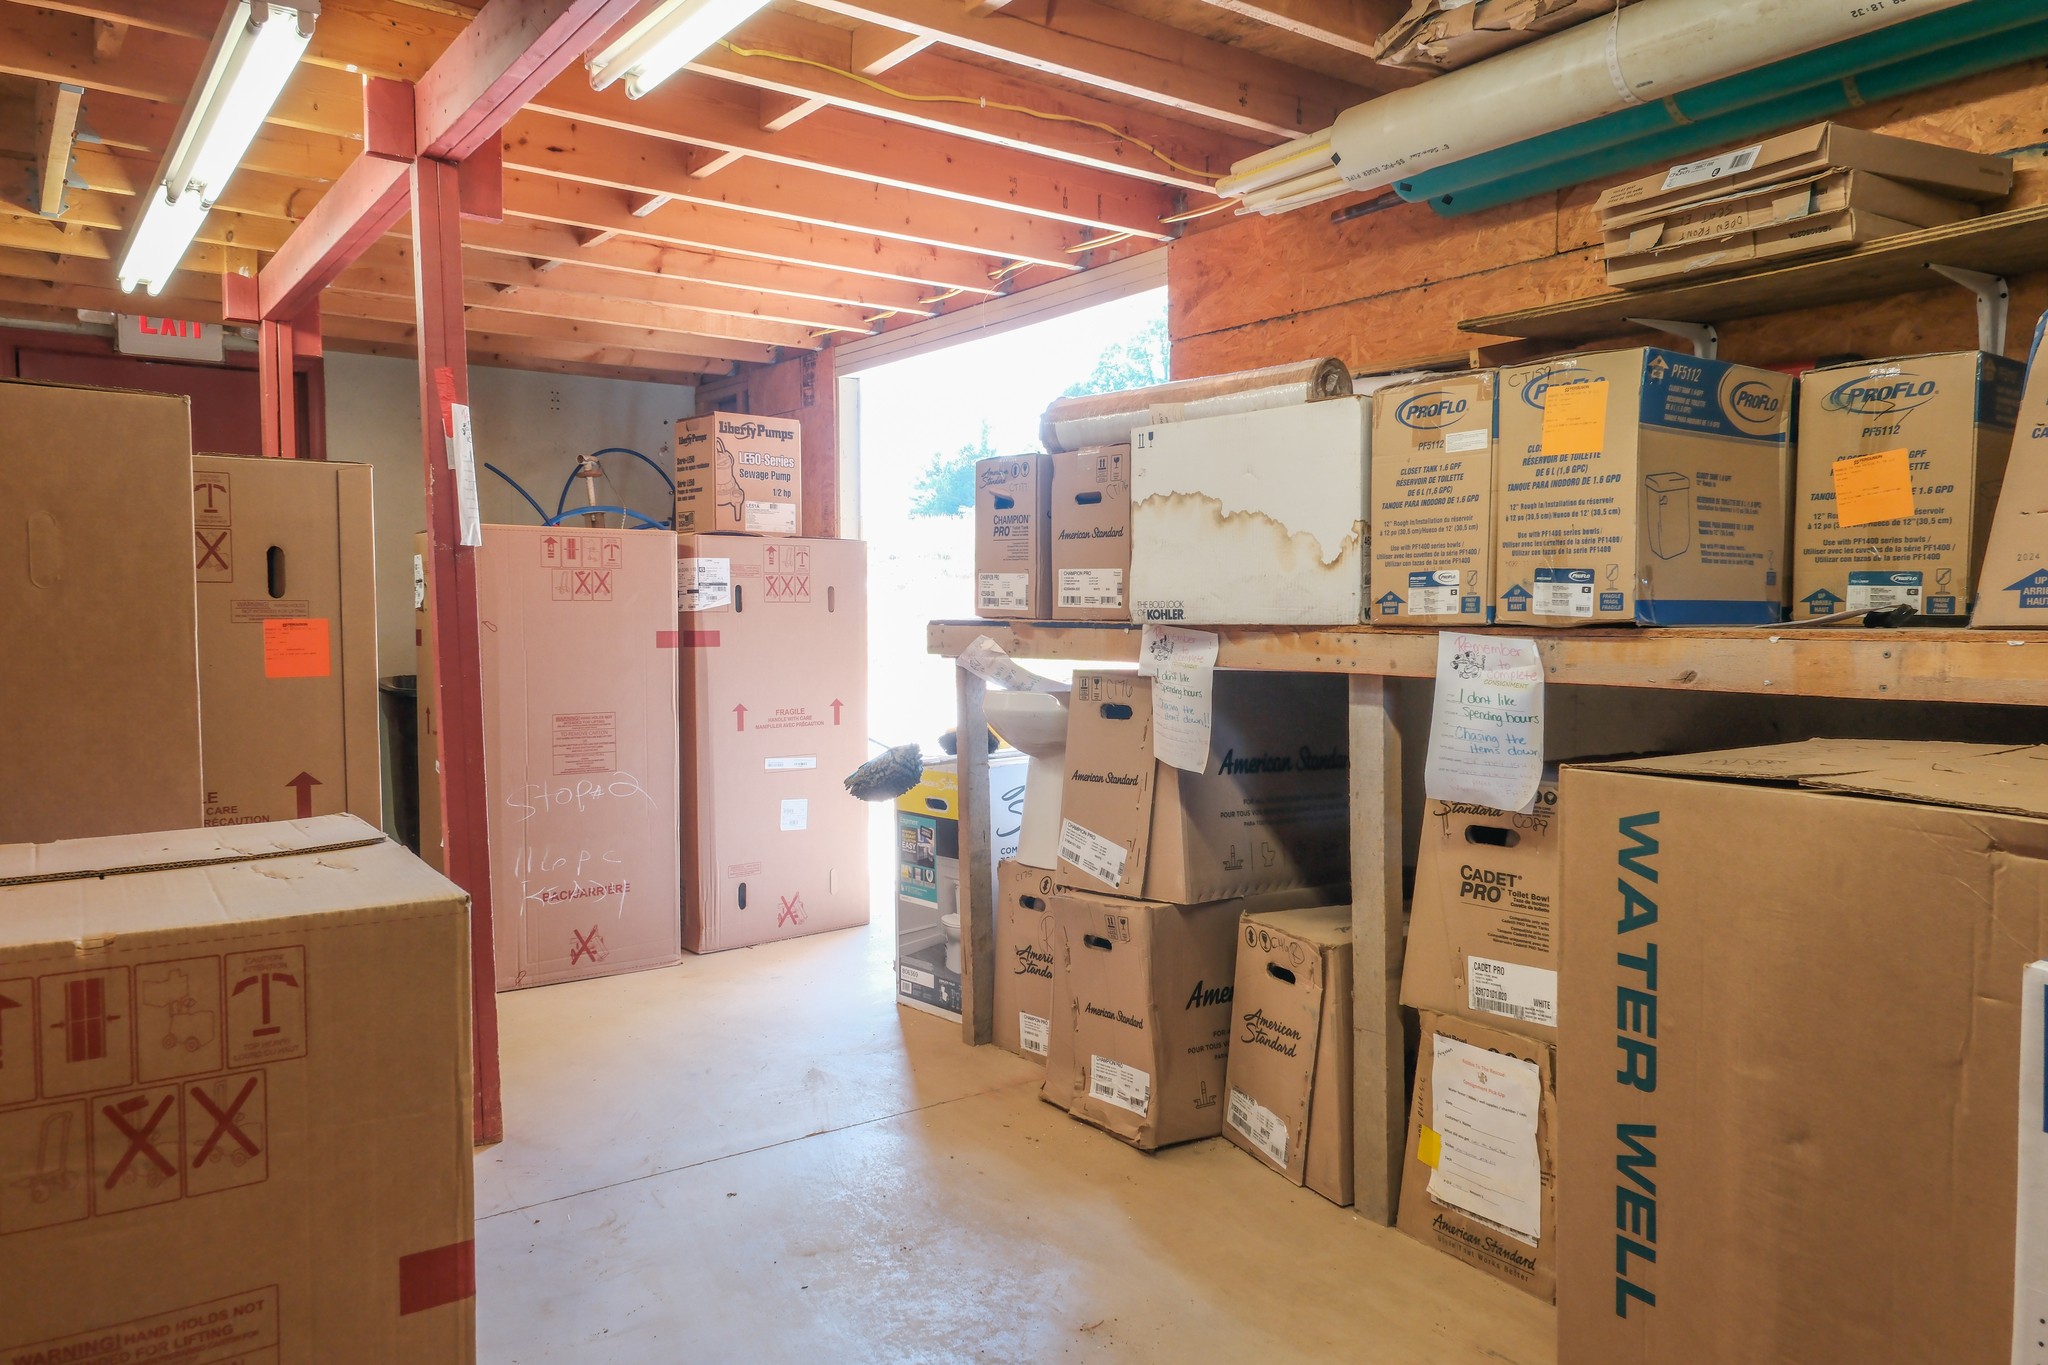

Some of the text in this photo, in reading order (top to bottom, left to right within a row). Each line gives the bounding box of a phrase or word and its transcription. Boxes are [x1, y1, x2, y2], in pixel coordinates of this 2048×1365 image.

[1678, 215, 1743, 241] OPEN FRONT
[1671, 363, 1702, 382] PF5112
[1849, 380, 1936, 403] PROFLO
[1736, 390, 1779, 412] PROFLO
[1406, 399, 1467, 420] PROFLO
[718, 420, 795, 442] Liberty Pumps
[1862, 424, 1901, 438] PF5112
[1417, 439, 1445, 451] PF5112
[738, 451, 796, 468] LE50-Series
[1522, 451, 1602, 466] RÉSERVOIR DE TOILETTE
[1909, 450, 1927, 459] GPF
[739, 468, 791, 482] Sewage Pump
[1400, 462, 1462, 476] CLOSET TANK 1.6 GPF
[1535, 464, 1589, 477] DE GPC)
[1395, 476, 1427, 487] RÉSERVOIR
[1437, 473, 1464, 483] TOILETTE
[1507, 474, 1622, 492] TANQUE PARA INODORO DE 1.6 GPD
[783, 488, 792, 498] hp
[1407, 486, 1453, 497] DE GPC)
[1919, 484, 1954, 495] 1.6 GPD
[1381, 494, 1480, 510] TANQUE PARA INODORO DE 1.6 GPD
[1520, 497, 1614, 511] Rough réservoir
[1608, 507, 1621, 516] cm)
[993, 514, 1030, 525] CHAMPION
[1393, 515, 1473, 528] Rough réservoir
[1937, 517, 1953, 525] cm)
[993, 525, 1011, 537] PRO
[1058, 526, 1124, 541] American Standard
[1853, 537, 1879, 545] PF1400
[1880, 536, 1903, 544] series
[1904, 535, 1926, 543] bowls
[1923, 543, 1951, 551] PF1400
[1912, 552, 1941, 561] PF1400
[2016, 553, 2041, 562] 2024
[2034, 577, 2048, 585] UP
[1137, 600, 1185, 609] THE BOLD LOOK
[1146, 608, 1184, 620] KOHLER
[1454, 636, 1522, 657] Remember
[1483, 678, 1529, 689] CONSIGNMENT
[1183, 687, 1203, 698] hours
[1458, 688, 1464, 703] I
[1497, 693, 1517, 707] like
[775, 707, 806, 716] FRAGILE
[1504, 711, 1540, 725] hours
[1455, 726, 1527, 746] Chasing the
[1218, 748, 1293, 775] American
[1071, 769, 1139, 786] American Standard
[206, 805, 239, 816] CARE
[1067, 821, 1087, 835] CHAMPION
[901, 841, 917, 850] EASY
[1460, 864, 1518, 888] CADET
[1459, 881, 1550, 904] PRO Toilet Bowl
[1616, 810, 1660, 1093] WATER
[242, 962, 288, 973] ATTENTION
[1473, 961, 1505, 976] CADET PRO
[1532, 998, 1551, 1010] WHITE
[1084, 1002, 1144, 1029] American Standard
[1243, 1008, 1302, 1041] American
[1213, 1029, 1225, 1038] FOR
[1240, 1022, 1297, 1058] Standard
[242, 1041, 262, 1050] TOP
[263, 1044, 300, 1058] DU HAUT
[1187, 1042, 1222, 1055] POUR TOUS
[1615, 1122, 1657, 1319] WELL
[1432, 1213, 1537, 1271] American Standard
[1477, 1253, 1501, 1269] Works
[124, 1300, 265, 1345] HAND HOLDS NOT
[135, 1341, 169, 1359] FOR
[173, 1323, 234, 1348] LIFTING
